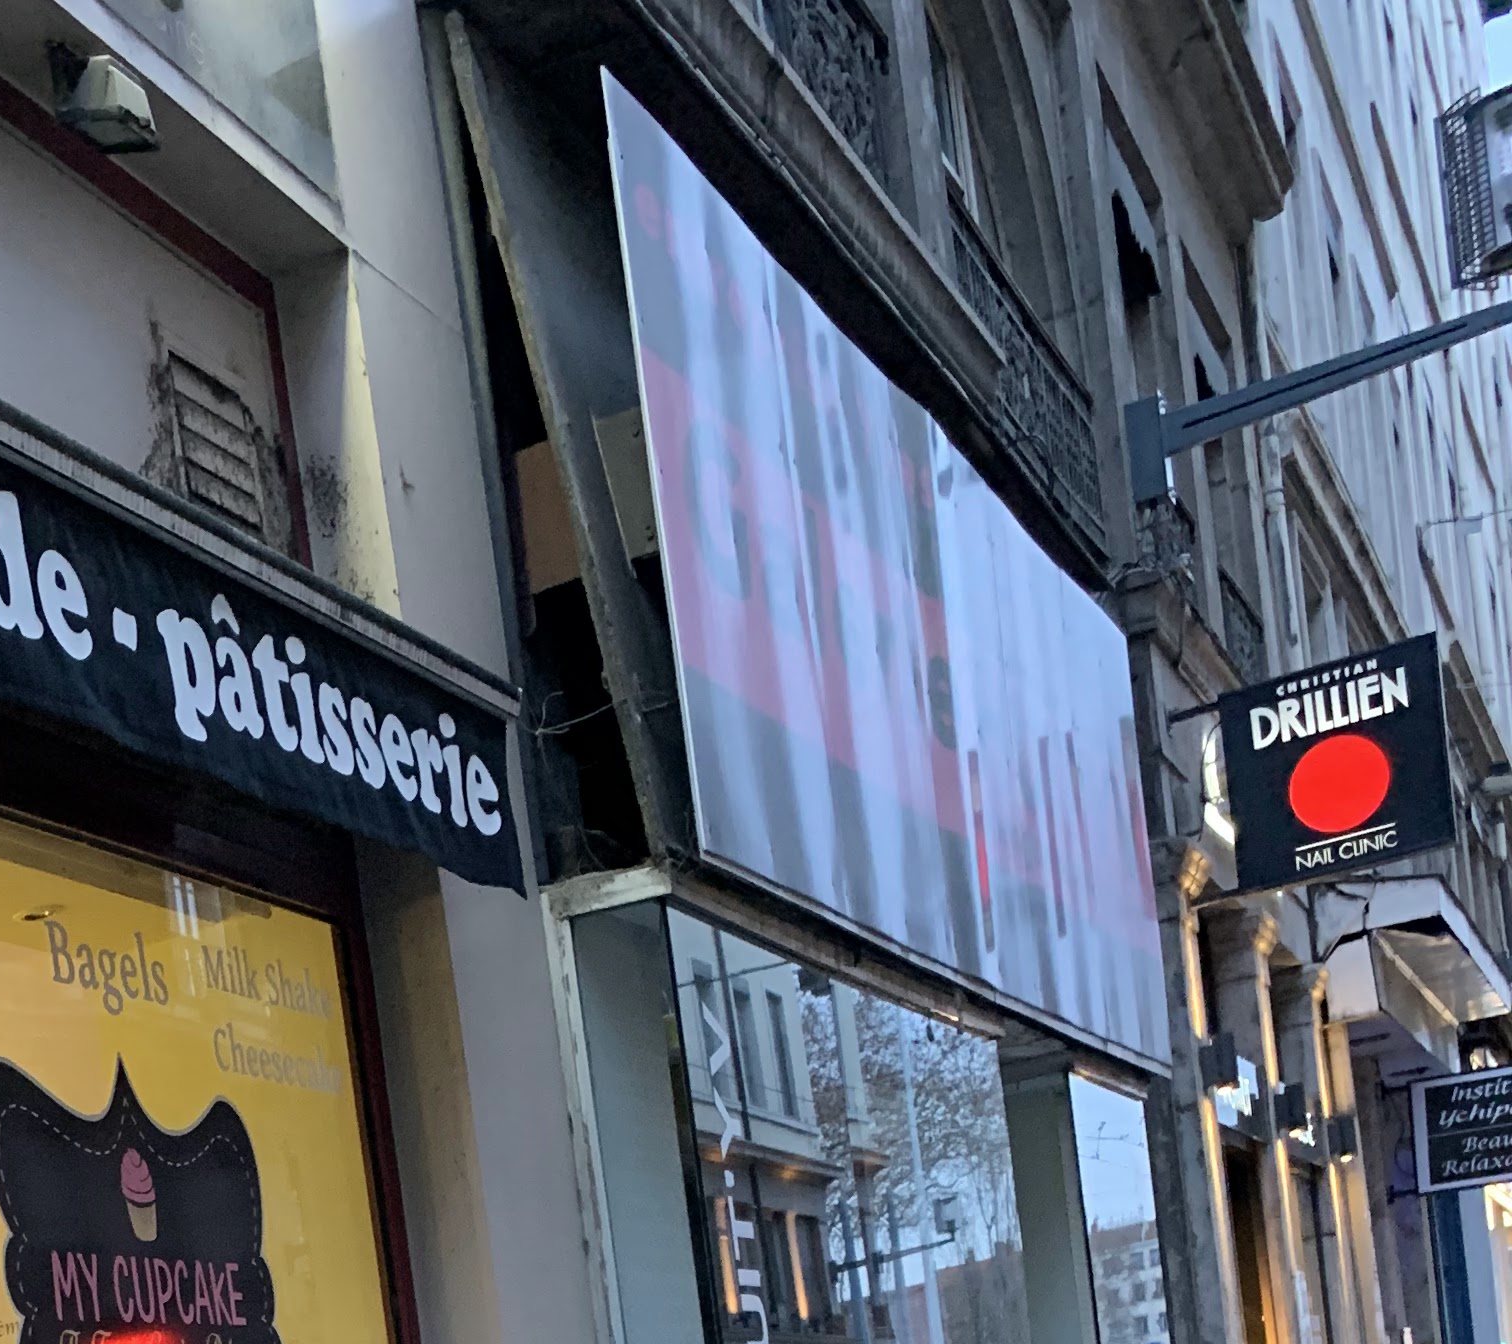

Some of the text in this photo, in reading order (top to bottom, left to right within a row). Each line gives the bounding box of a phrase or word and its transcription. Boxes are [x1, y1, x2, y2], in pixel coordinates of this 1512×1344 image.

[157, 593, 503, 837] pâtisserie
[1249, 666, 1410, 750] DRILLIEN
[1276, 658, 1378, 697] CHRISTIAN
[1295, 829, 1398, 872] NAIL CLINIC
[44, 920, 170, 1016] Bagels
[201, 945, 263, 1001] Milk
[50, 1250, 247, 1326] MY CUPCAKE
